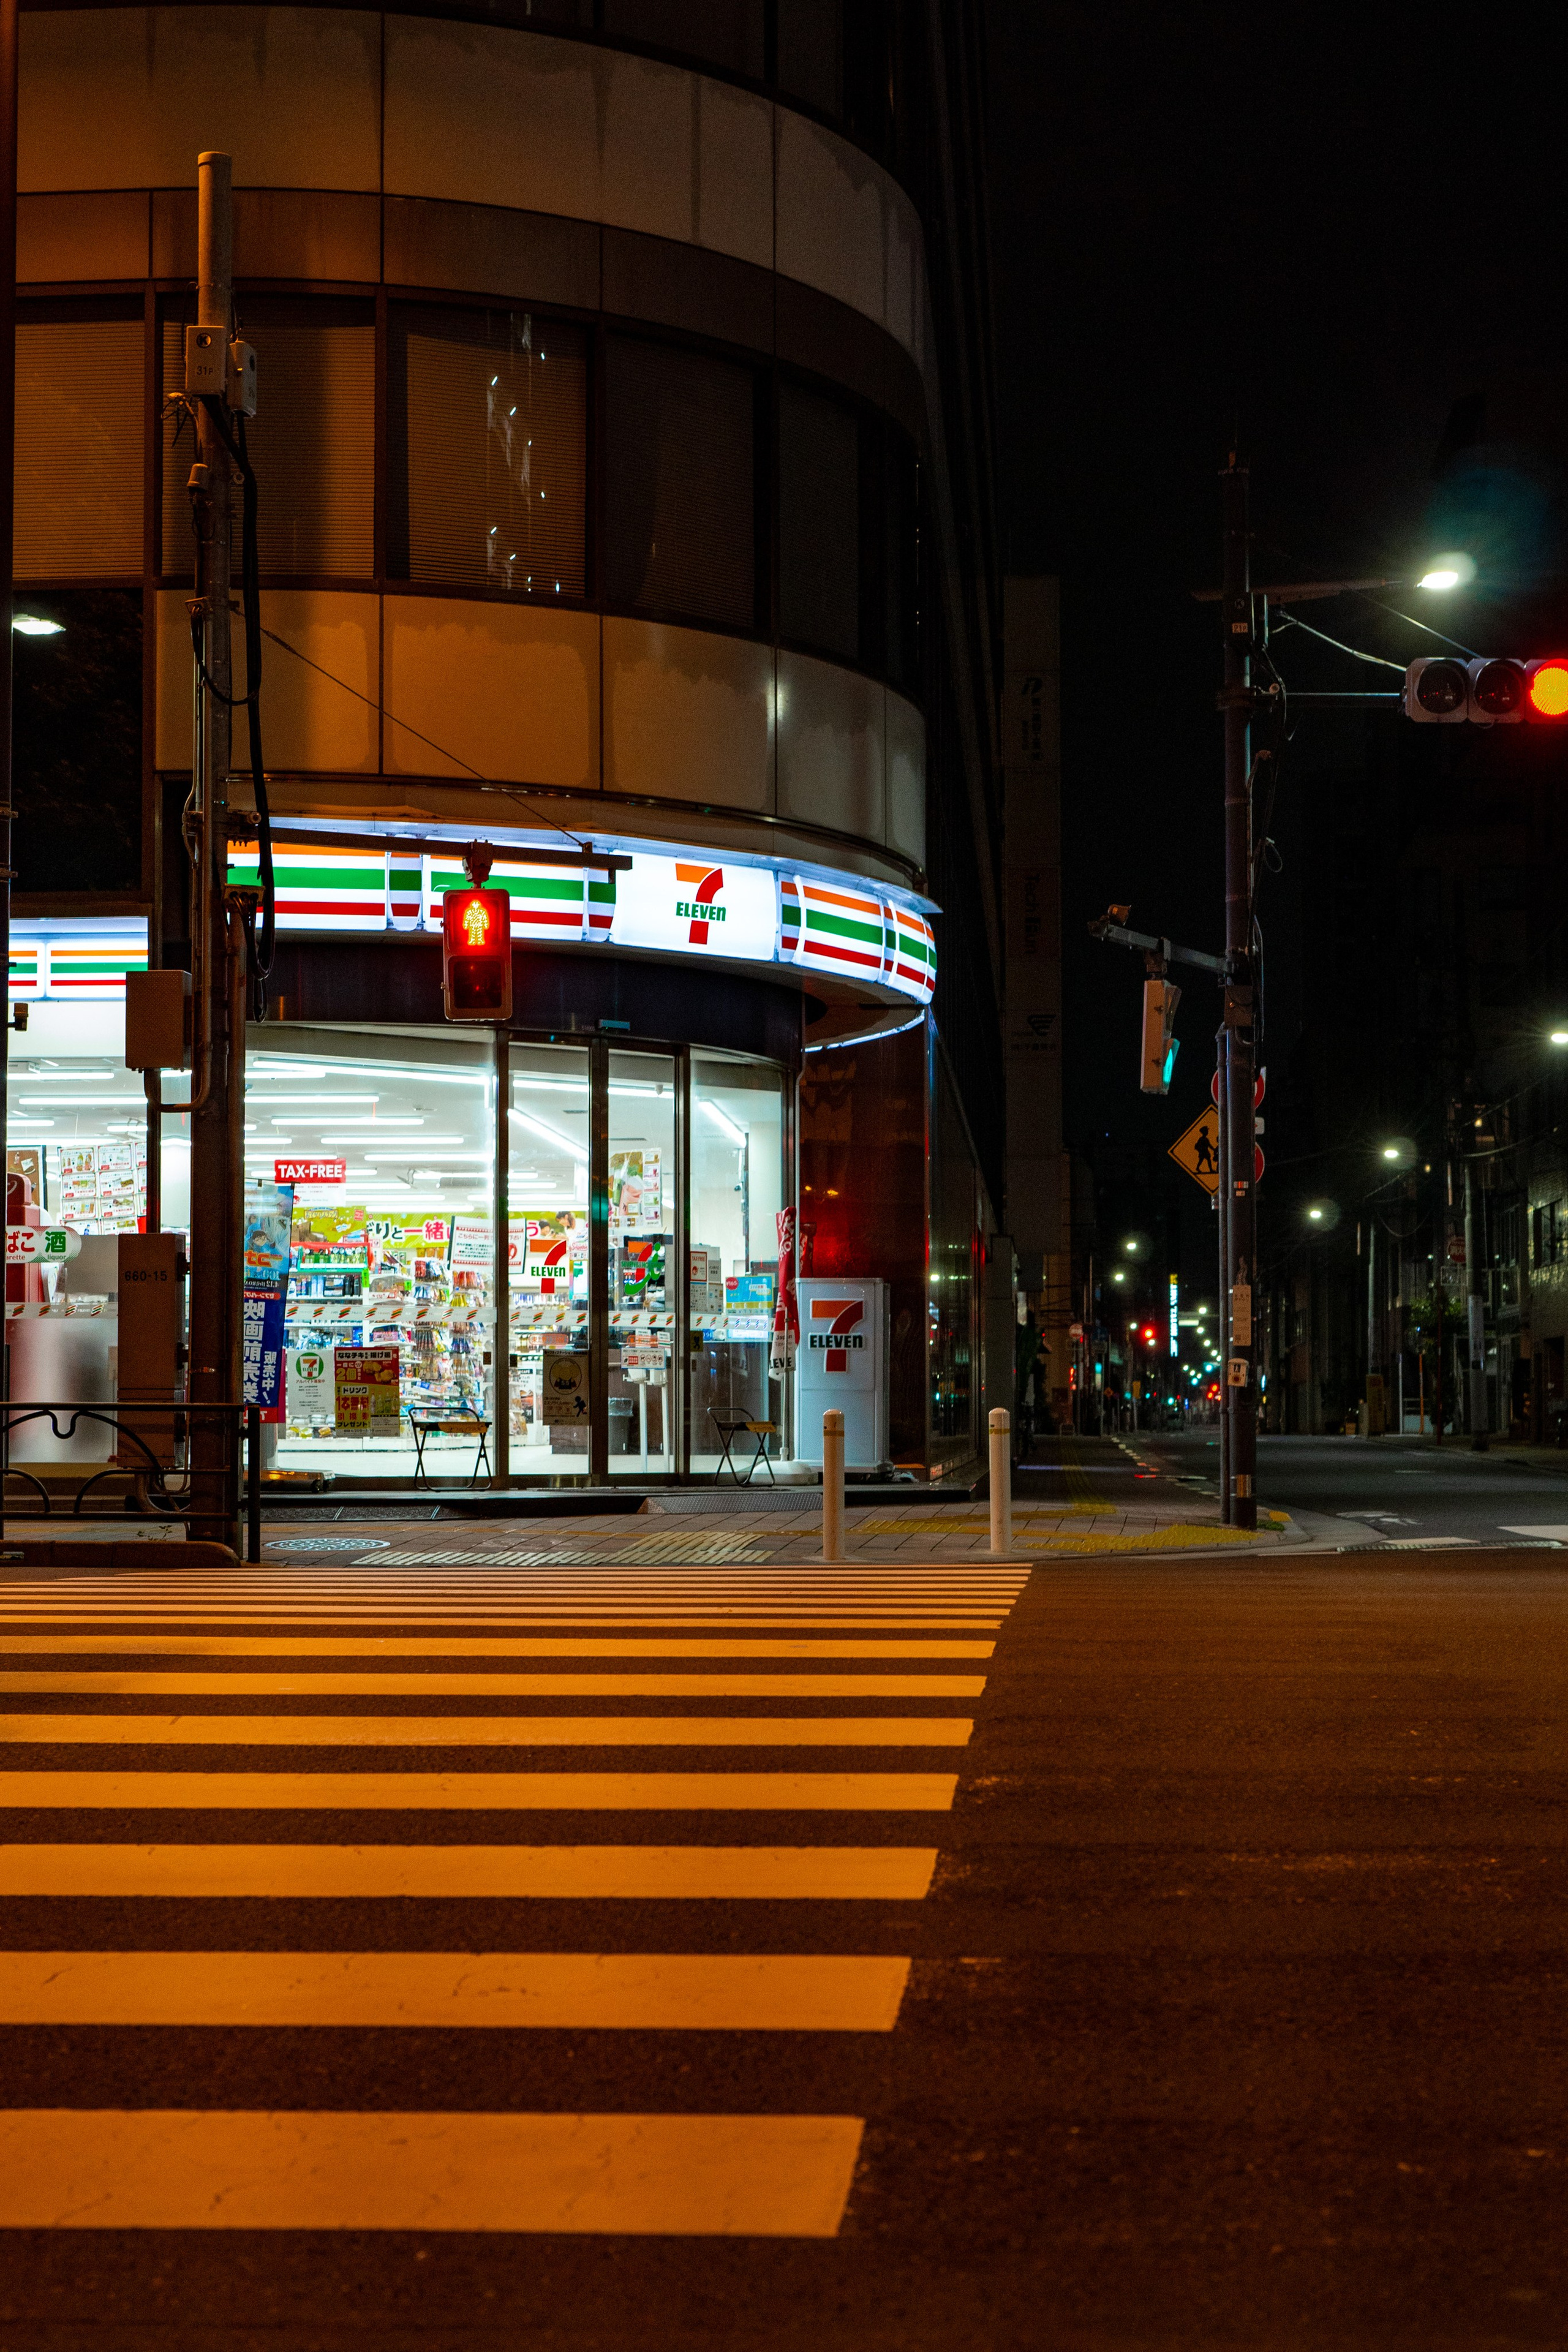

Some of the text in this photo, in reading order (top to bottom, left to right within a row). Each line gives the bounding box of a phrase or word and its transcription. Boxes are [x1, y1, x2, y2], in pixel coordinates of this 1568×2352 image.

[278, 1164, 342, 1178] TAX-FREE
[6, 1231, 66, 1253] ばこ 酒
[124, 1270, 167, 1281] 660-15
[769, 1357, 792, 1369] LEVE
[336, 1368, 357, 1381] 2個
